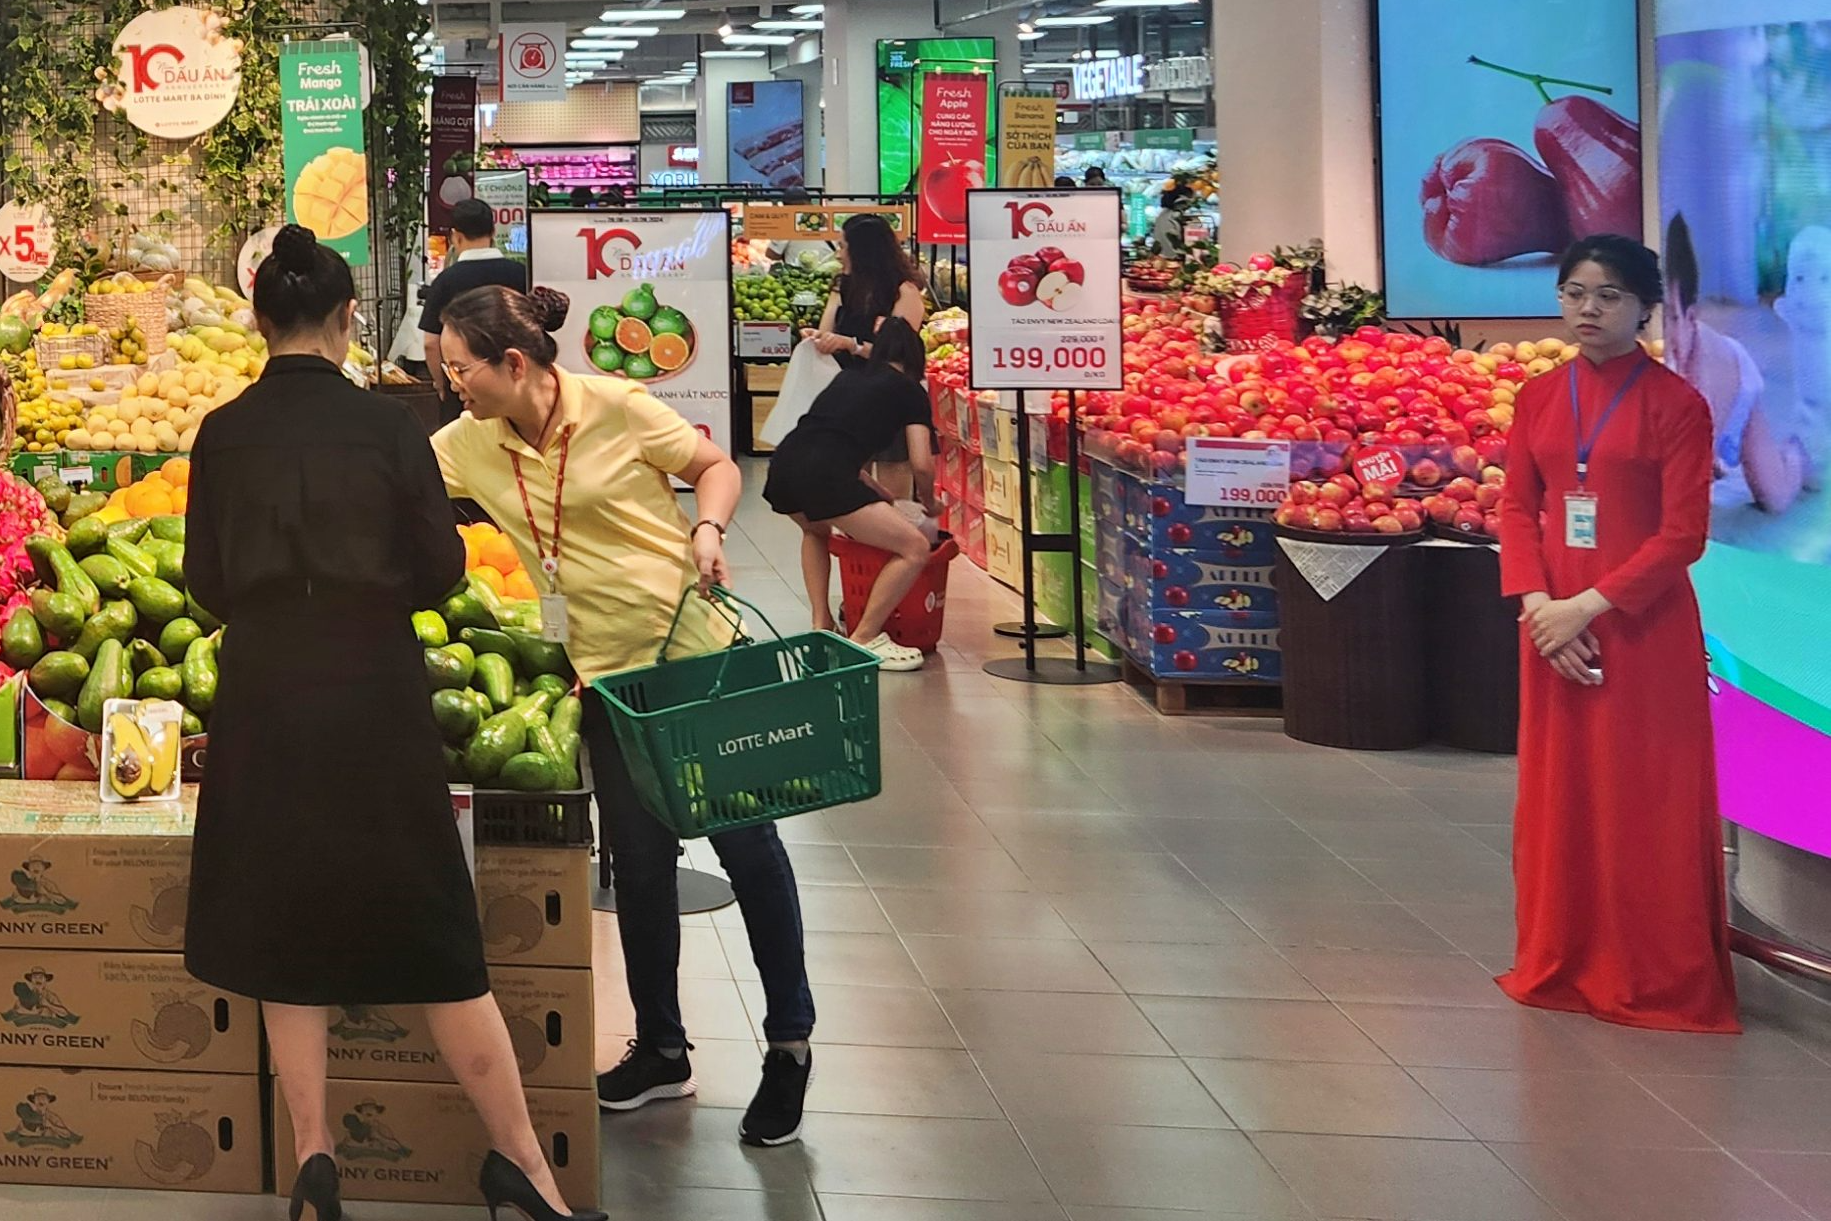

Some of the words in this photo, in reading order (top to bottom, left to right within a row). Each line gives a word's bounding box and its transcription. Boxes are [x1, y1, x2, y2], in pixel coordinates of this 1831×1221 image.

[298, 60, 342, 76] Fresh
[300, 77, 342, 90] Mango
[1072, 54, 1145, 100] VEGETABLE
[134, 96, 160, 104] LOTTE
[936, 87, 972, 98] Fresh
[286, 96, 320, 113] TRÁI
[321, 94, 356, 111] XOÀI
[940, 99, 968, 109] Apple
[992, 346, 1107, 372] 199,000
[1220, 487, 1287, 504] 199,000
[717, 733, 764, 756] LOTTE
[767, 722, 815, 745] Mart
